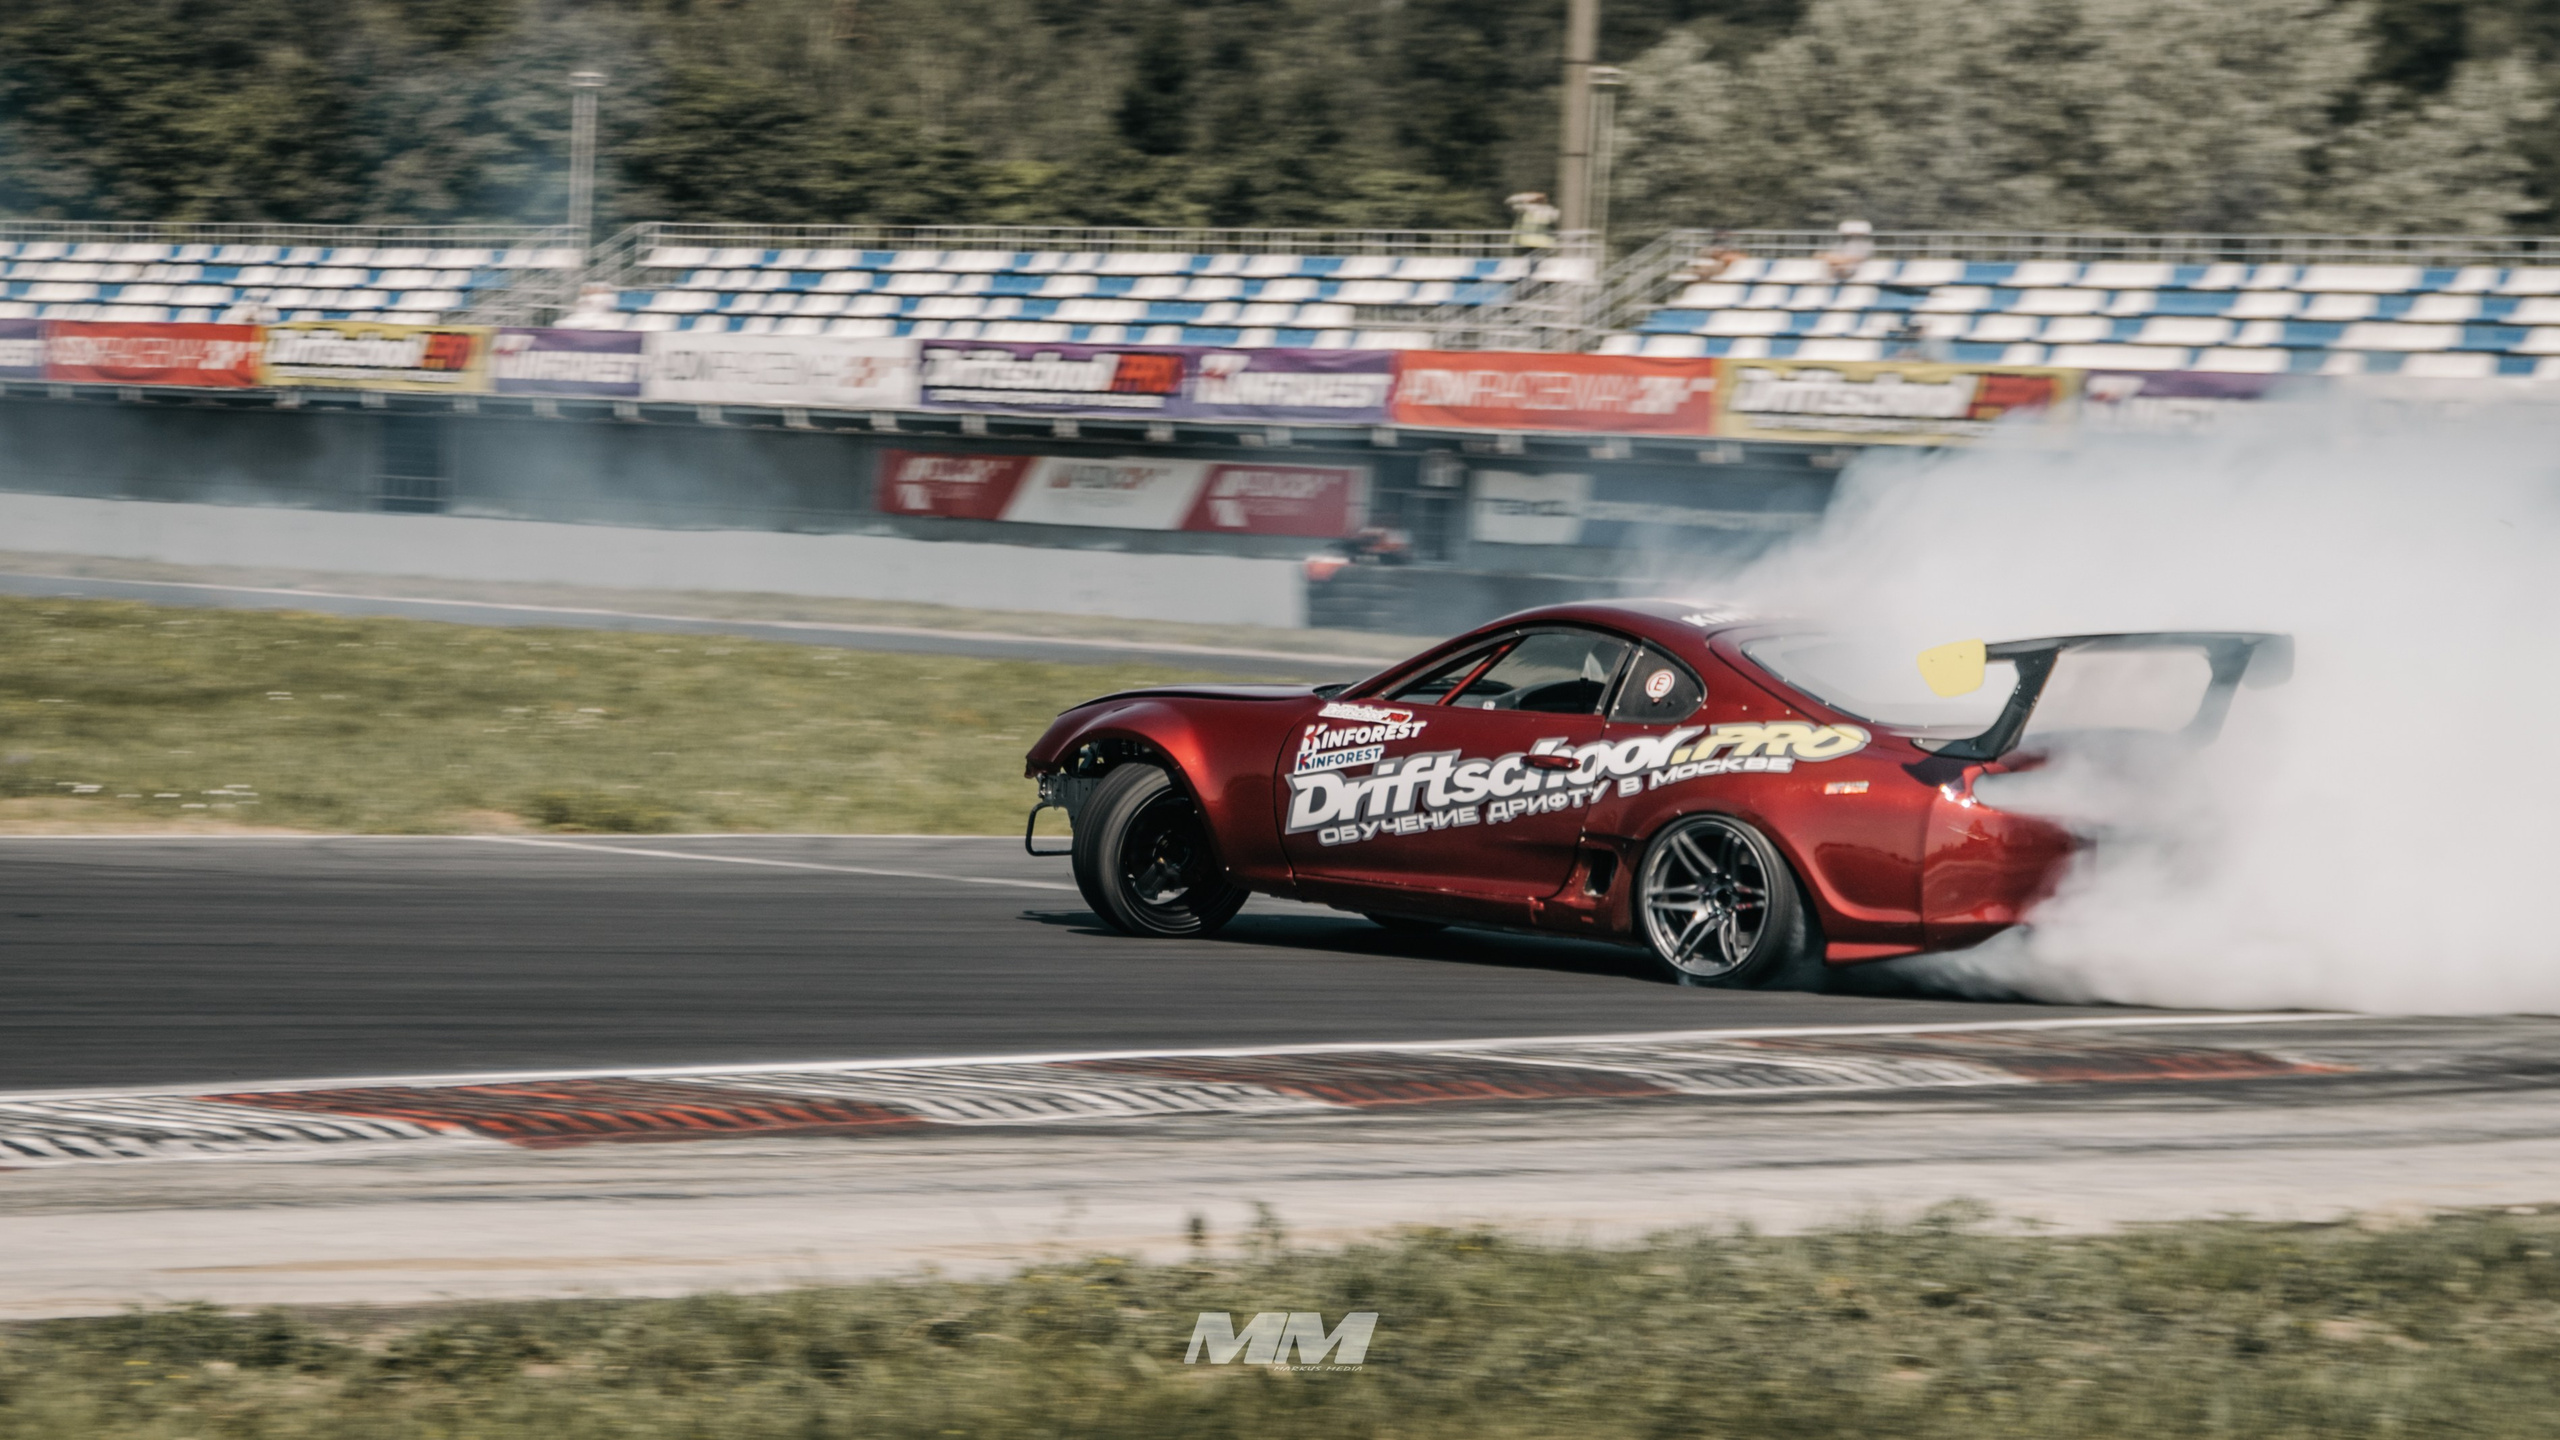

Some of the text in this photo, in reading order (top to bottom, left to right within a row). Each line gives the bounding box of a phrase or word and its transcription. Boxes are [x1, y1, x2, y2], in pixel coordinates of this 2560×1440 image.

[1300, 711, 1427, 752] KINFOREST
[1297, 747, 1381, 772] KINFOREST
[1320, 757, 1792, 844] ОБУЧЕНИЕ ДРИФТУ В МОСКВЕ
